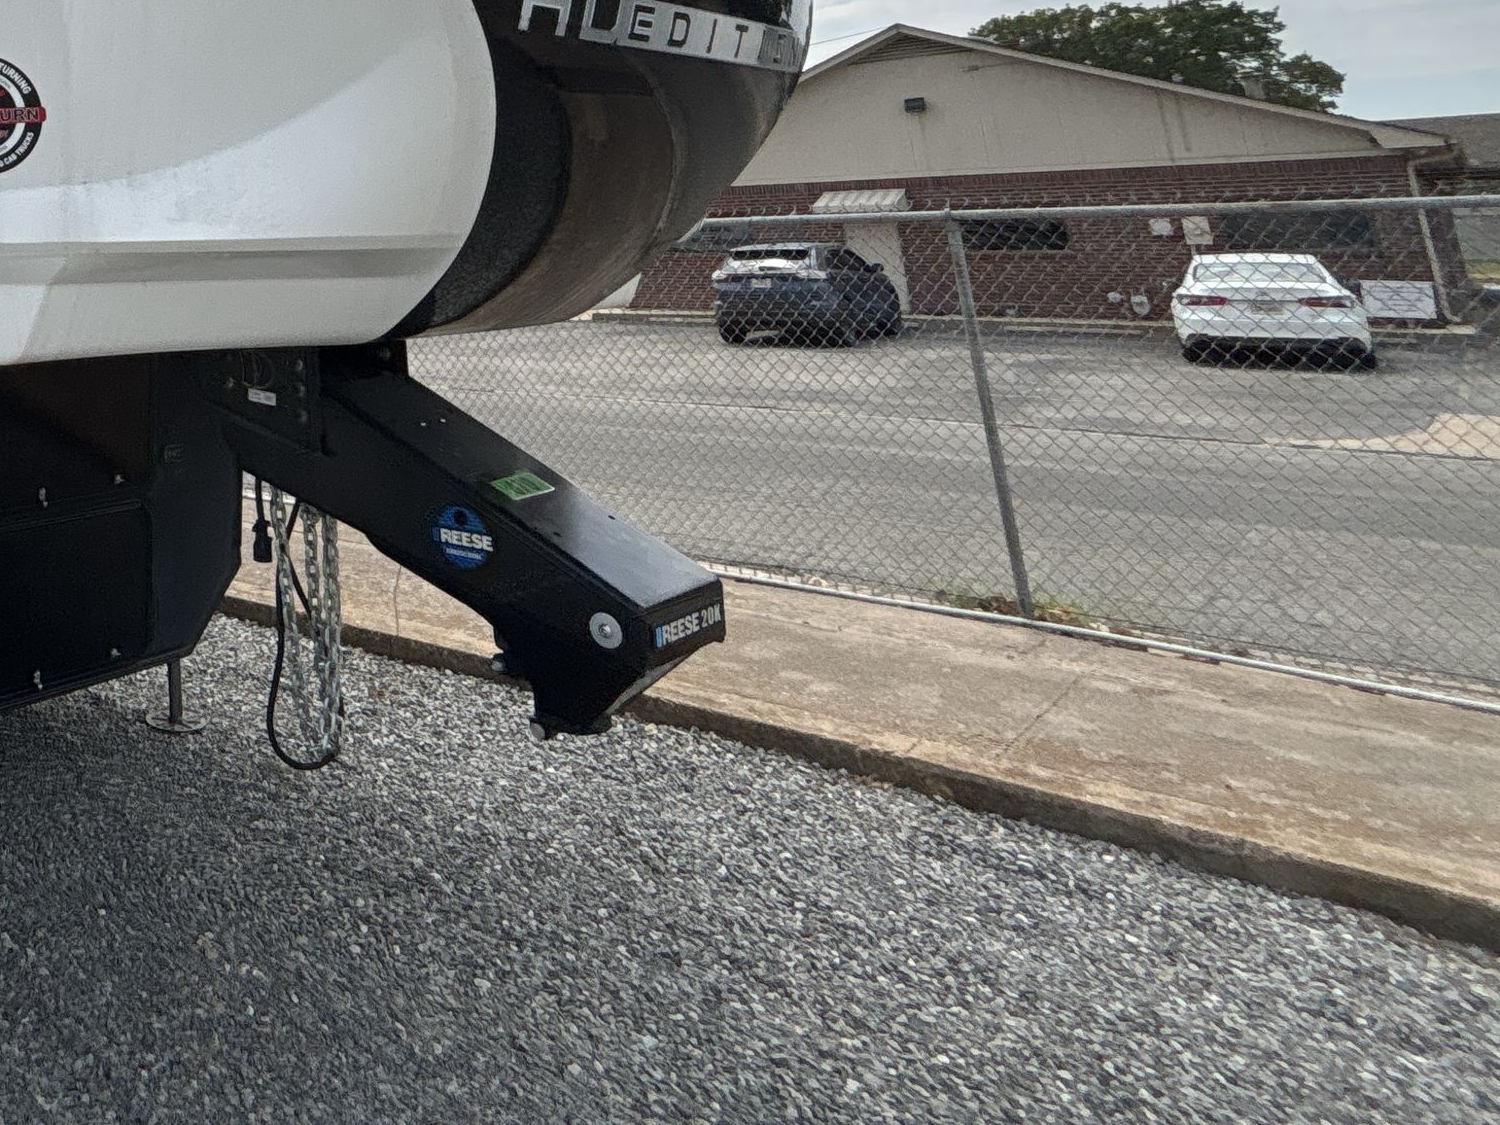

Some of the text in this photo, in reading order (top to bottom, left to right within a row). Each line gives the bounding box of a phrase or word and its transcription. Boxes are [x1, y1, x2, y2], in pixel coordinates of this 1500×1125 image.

[627, 3, 800, 68] EDIT
[3, 152, 18, 165] CAB
[15, 131, 35, 156] TRUCKS
[440, 527, 493, 552] REESE
[662, 603, 721, 646] REESE 20K
